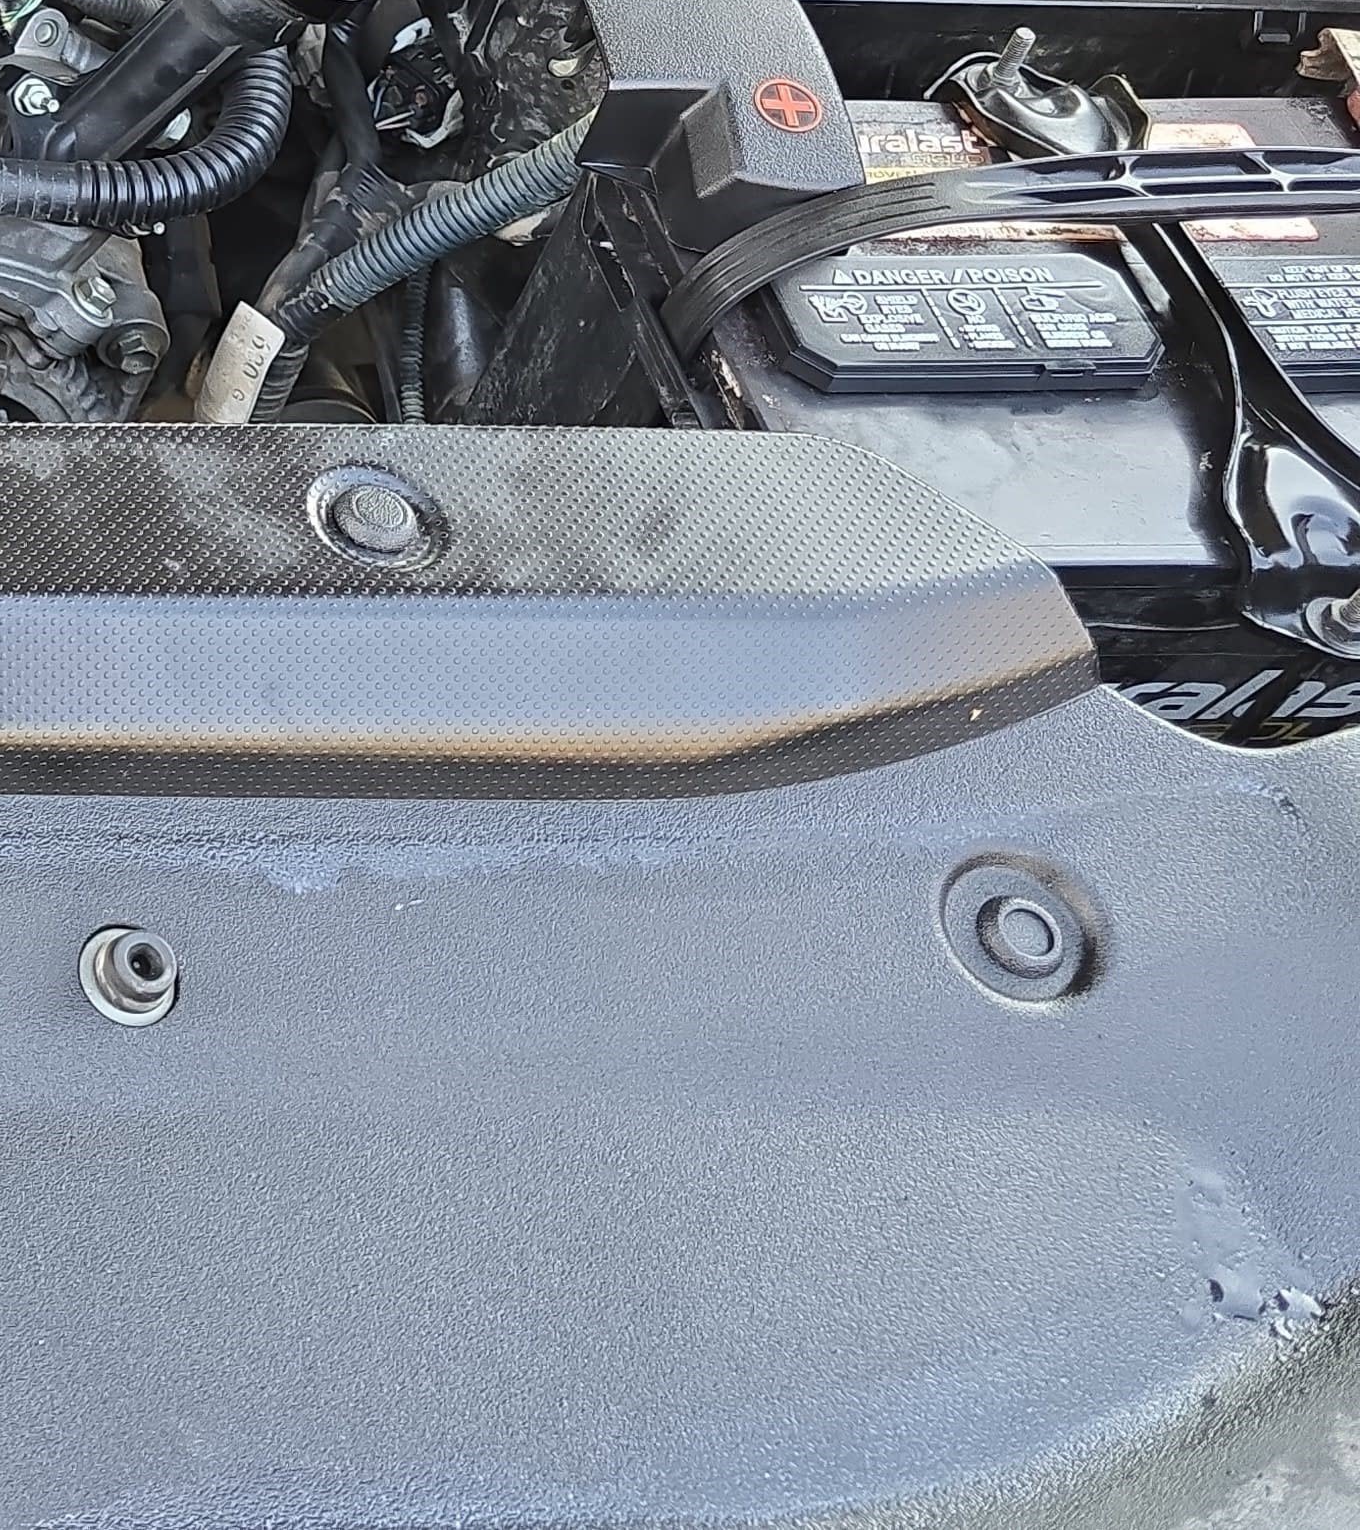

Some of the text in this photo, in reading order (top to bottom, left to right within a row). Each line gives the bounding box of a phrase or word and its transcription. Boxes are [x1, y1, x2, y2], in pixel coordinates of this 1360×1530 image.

[859, 129, 982, 154] ralast
[852, 269, 946, 286] DANGER
[967, 268, 1055, 284] POISON
[1277, 289, 1313, 300] FLUSH
[1315, 288, 1348, 298] EYES
[1283, 299, 1316, 310] WITH
[1289, 308, 1344, 320] MEDICAL
